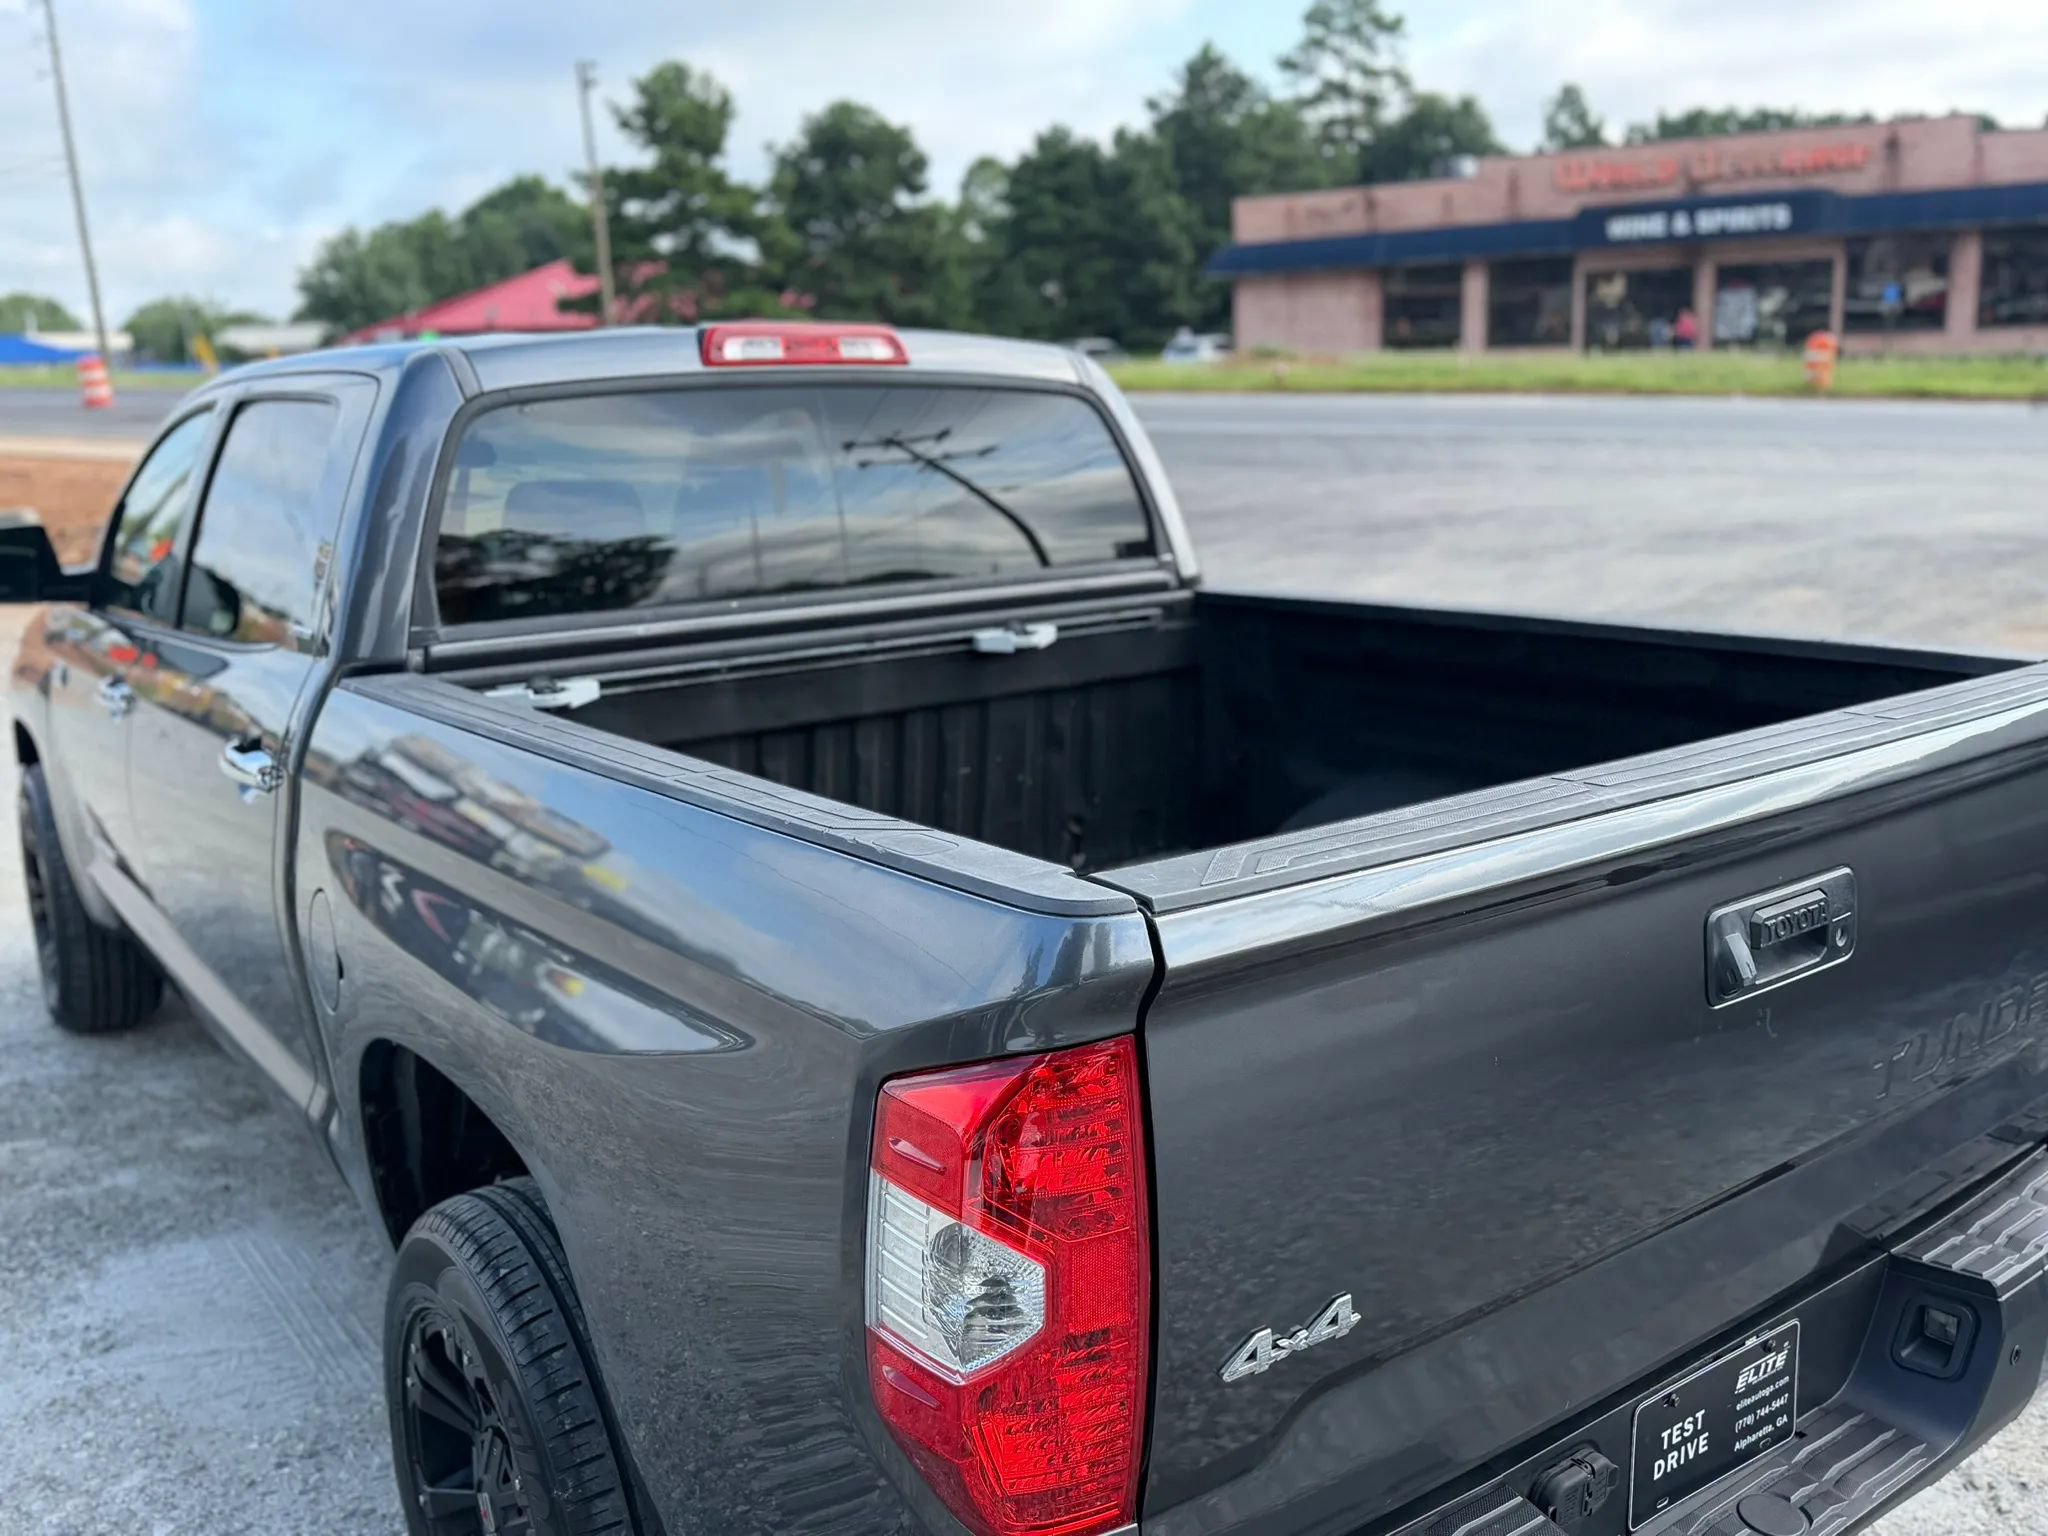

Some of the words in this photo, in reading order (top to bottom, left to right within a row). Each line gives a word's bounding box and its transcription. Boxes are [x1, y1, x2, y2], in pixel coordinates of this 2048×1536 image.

[1605, 211, 1667, 241] WINE
[1672, 210, 1692, 238] &
[1695, 203, 1792, 236] SPIRITS
[1762, 901, 1828, 942] TOYOTA
[1735, 1350, 1788, 1391] ELITE
[1735, 1413, 1755, 1434] (770)
[1756, 1393, 1789, 1420] 744-5447
[1736, 1376, 1789, 1411] eliteautoga.com
[1661, 1409, 1706, 1450] TEST
[1734, 1424, 1774, 1452] Alpharetta,
[1776, 1413, 1788, 1427] GA
[1653, 1432, 1709, 1481] DRIVE
